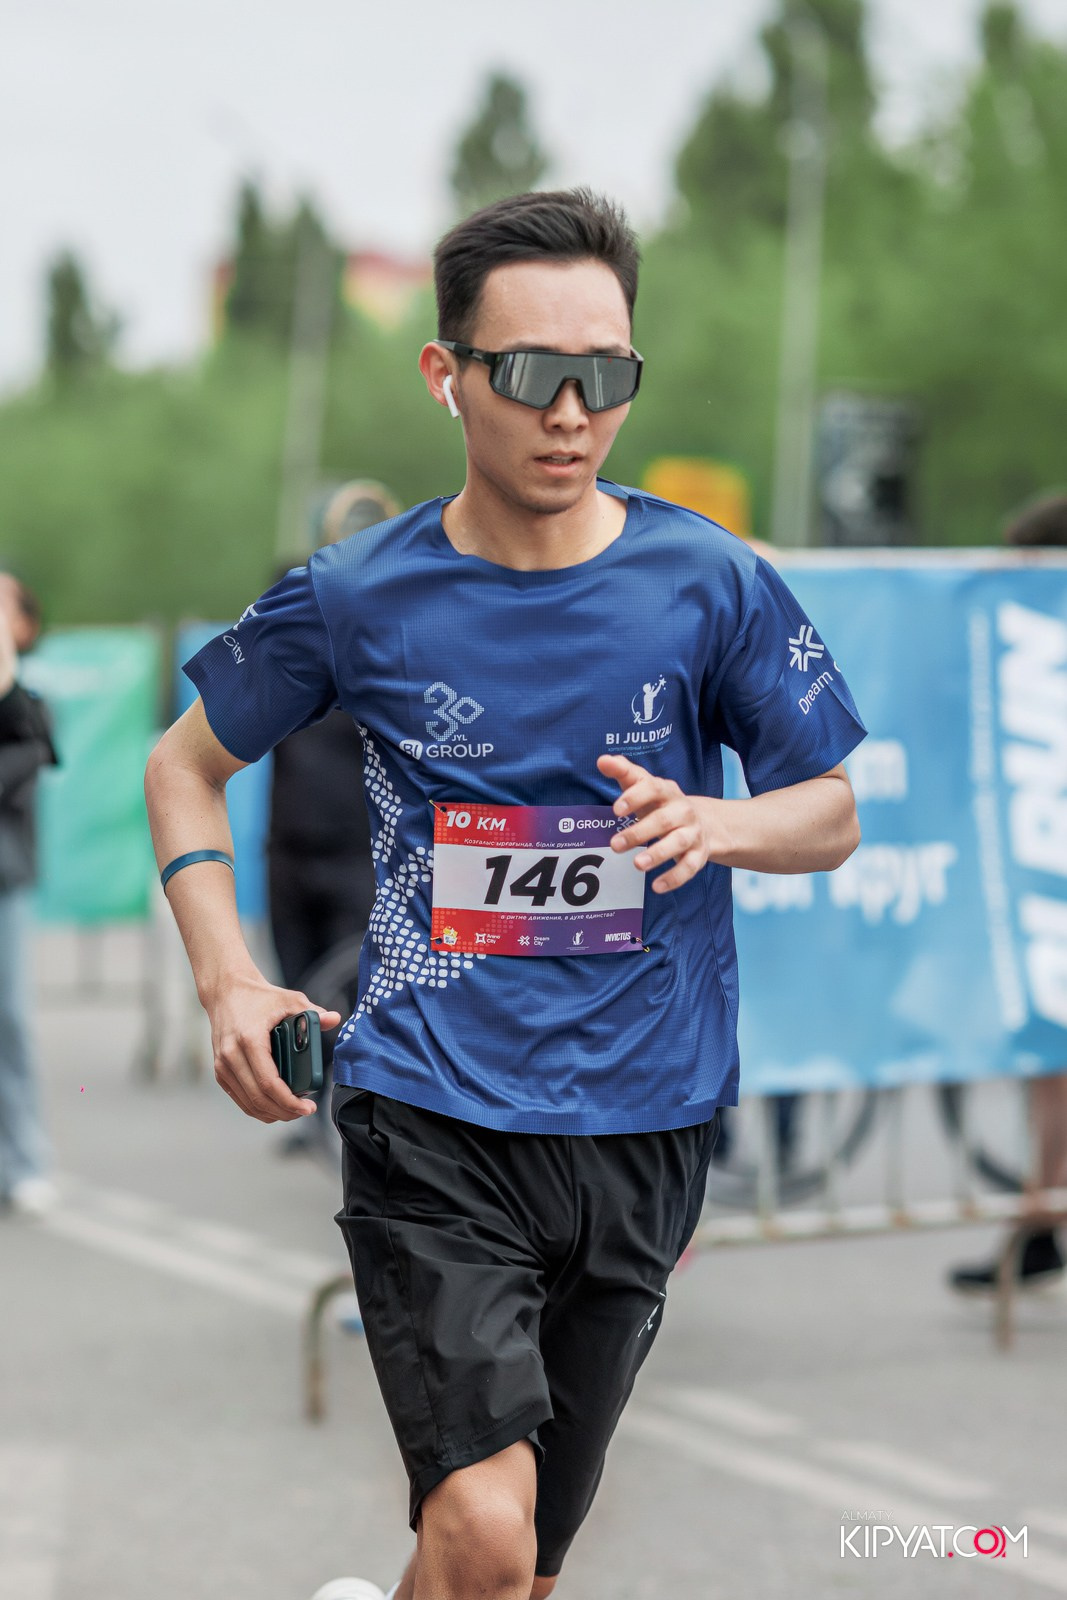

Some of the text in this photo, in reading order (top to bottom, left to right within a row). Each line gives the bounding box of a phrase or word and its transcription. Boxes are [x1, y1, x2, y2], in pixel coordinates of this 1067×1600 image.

[223, 635, 245, 664] City
[798, 671, 834, 715] Dream
[424, 682, 485, 742] 30
[452, 734, 468, 742] JYL
[606, 733, 620, 745] BI
[426, 743, 494, 758] GROUP
[446, 810, 507, 832] 10 KM
[576, 819, 616, 830] GROUP
[484, 854, 605, 907] 146
[604, 932, 632, 943] INVICTUS
